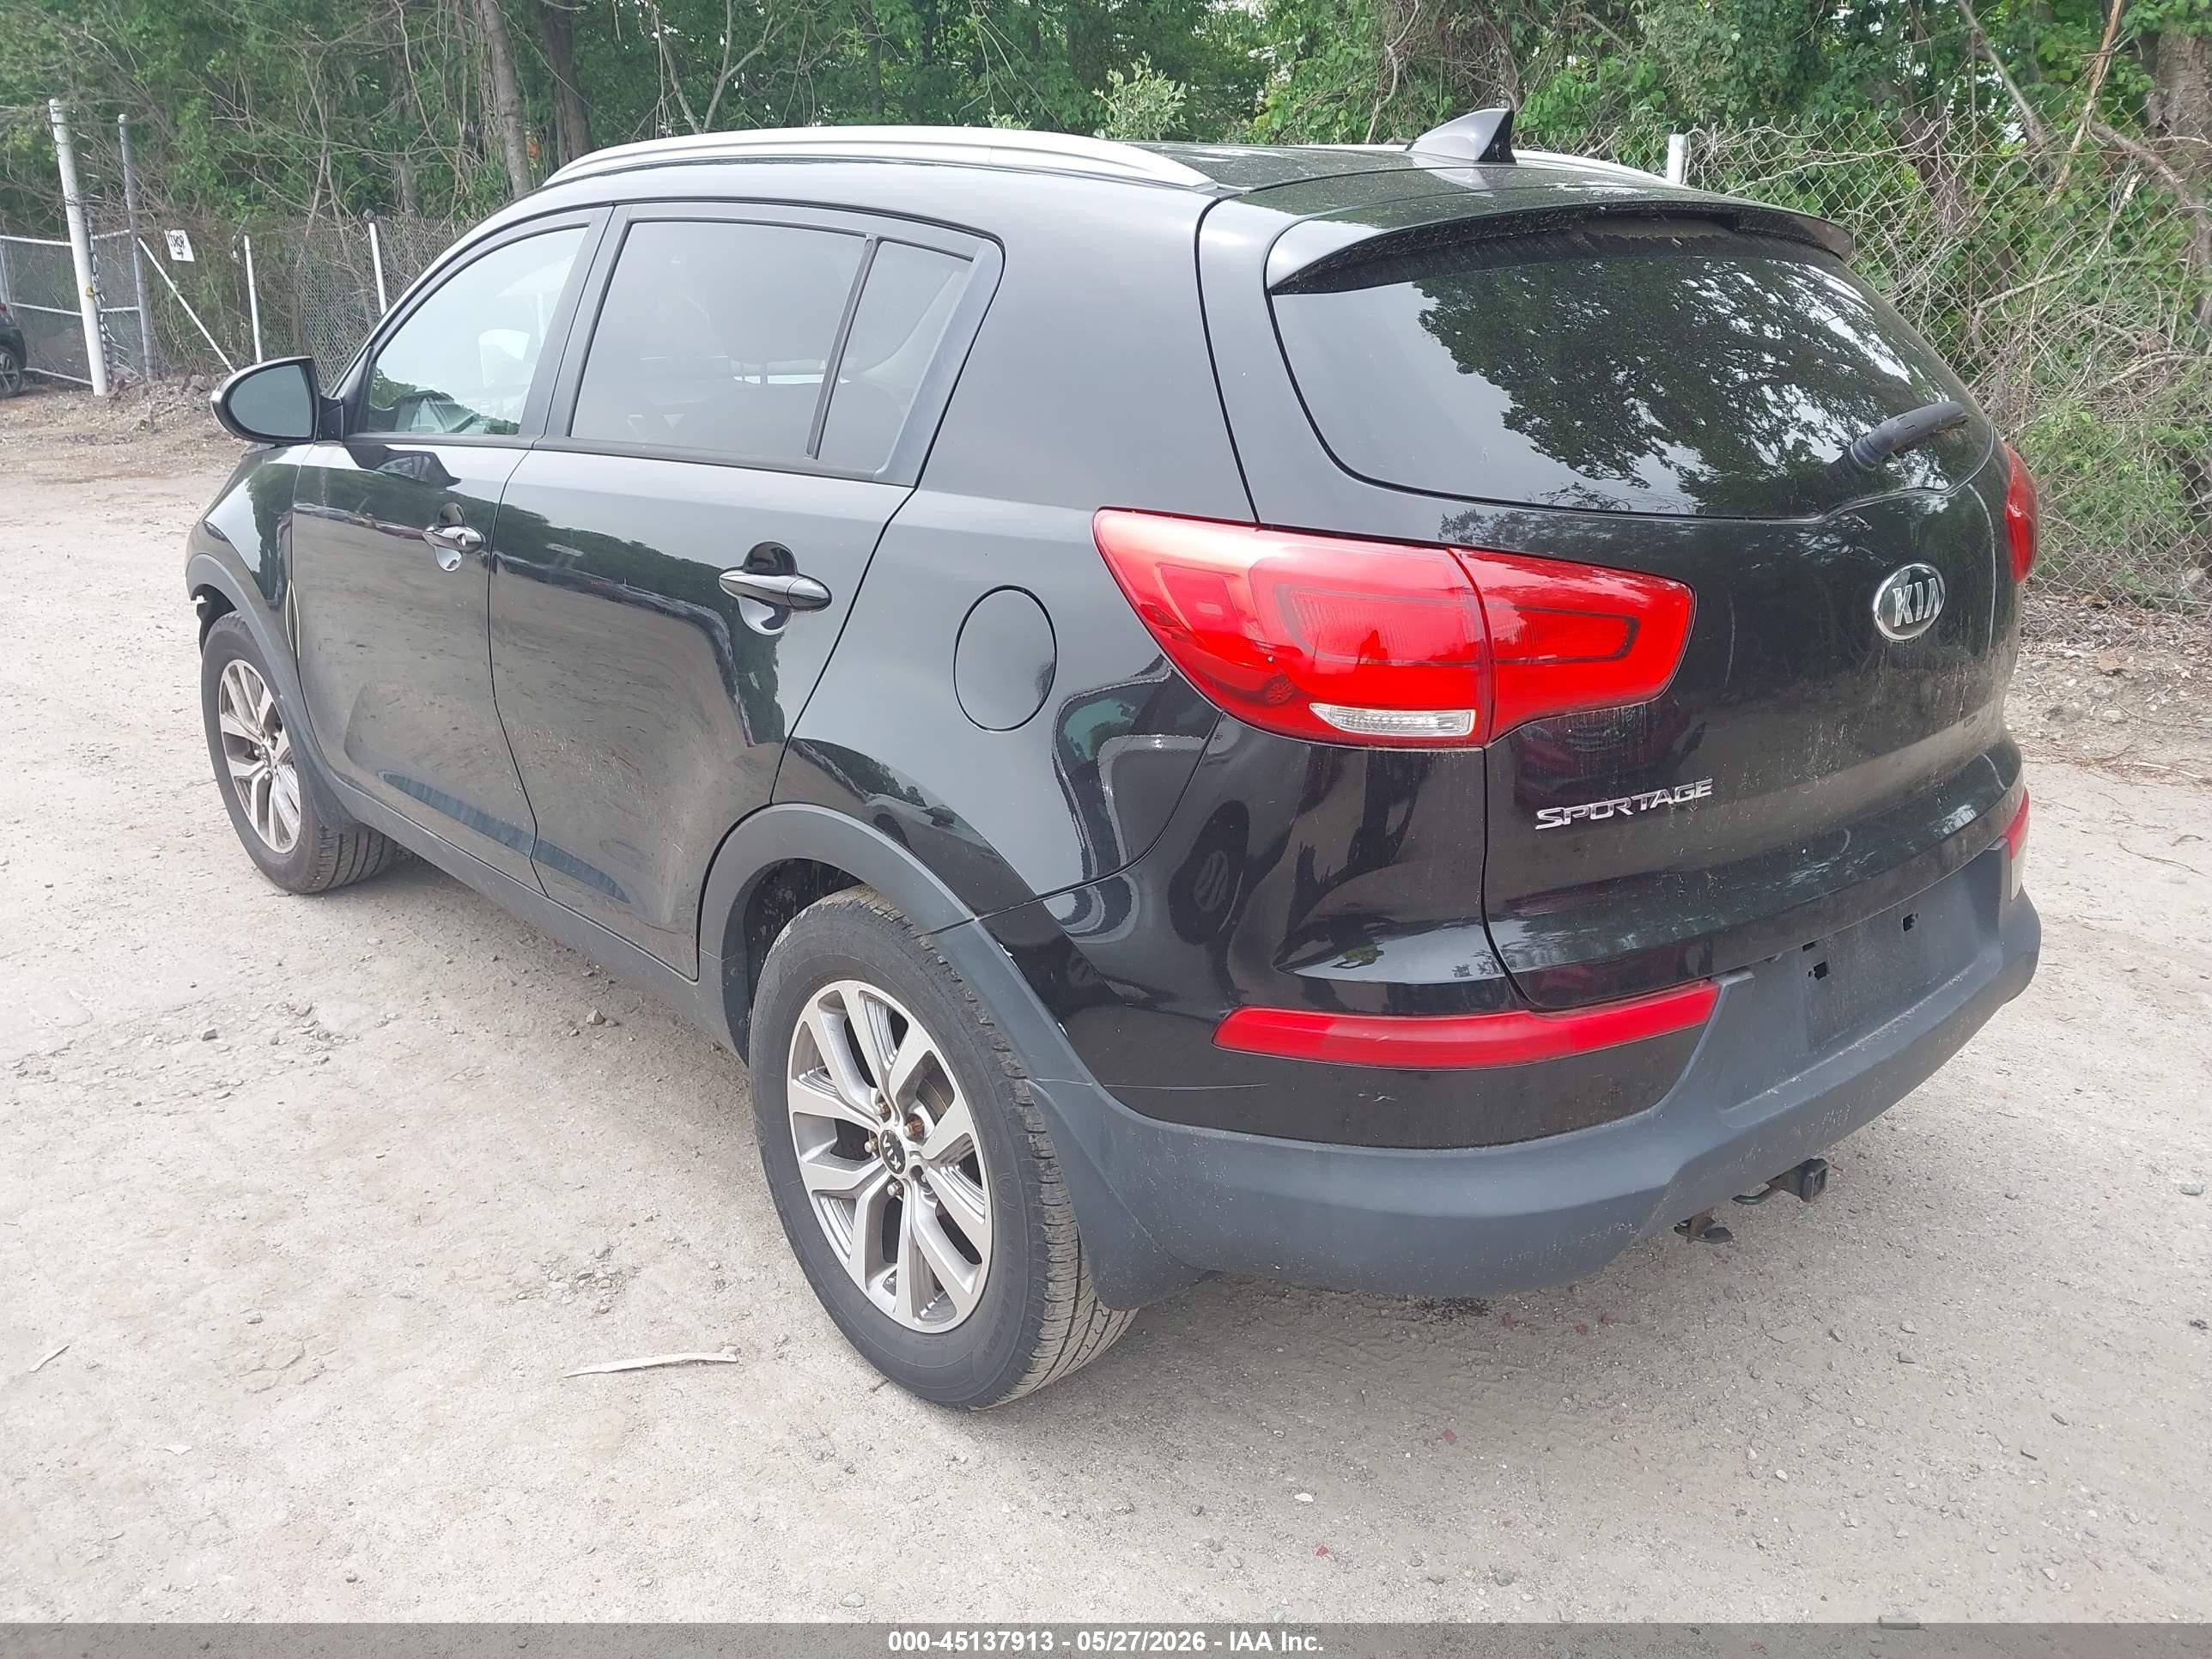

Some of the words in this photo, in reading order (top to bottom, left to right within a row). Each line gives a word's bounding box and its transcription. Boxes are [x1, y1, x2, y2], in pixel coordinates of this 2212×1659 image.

[1893, 578, 1940, 627] KIA
[1535, 778, 1713, 830] SPORTAGE
[882, 1134, 902, 1170] KIA
